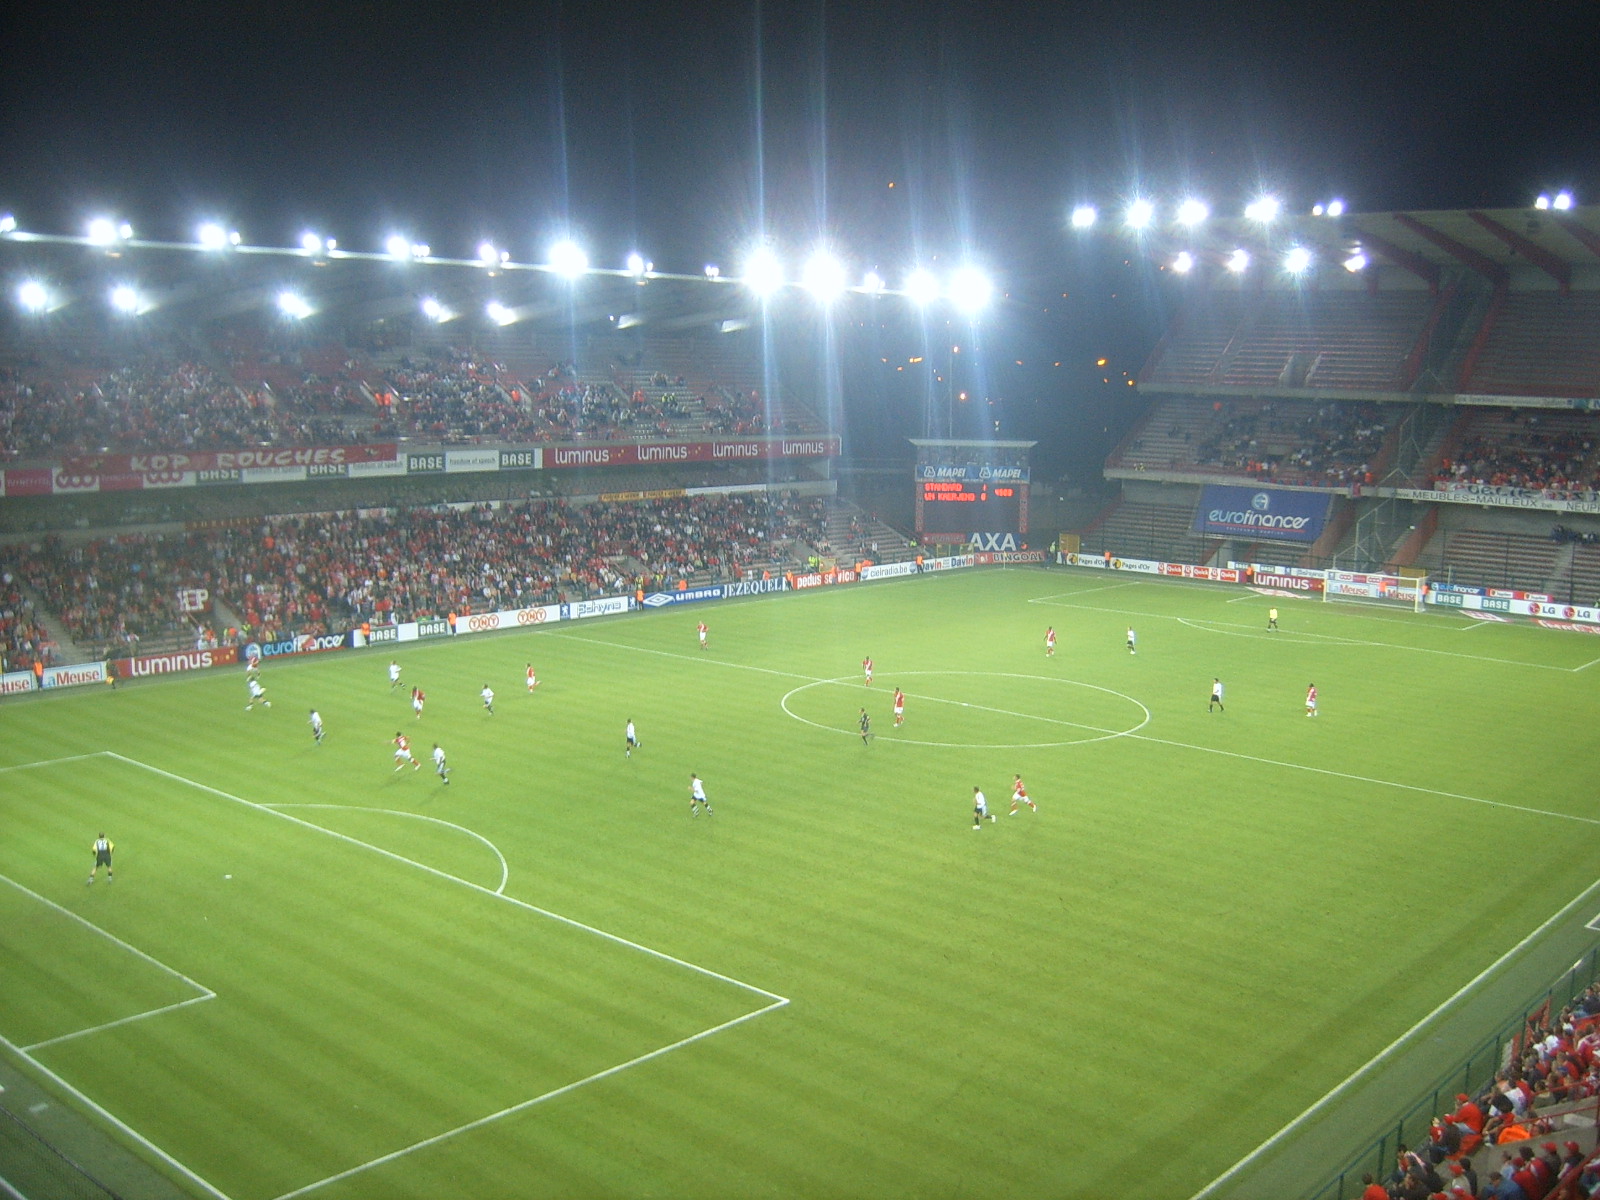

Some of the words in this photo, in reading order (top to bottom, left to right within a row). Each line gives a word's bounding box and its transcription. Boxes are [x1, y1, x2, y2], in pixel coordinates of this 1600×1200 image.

[637, 445, 687, 460] luminus
[713, 442, 758, 458] luminus
[782, 440, 824, 455] luminus
[502, 453, 531, 466] BASE
[555, 448, 609, 464] luminus
[410, 456, 443, 470] BASE
[937, 468, 966, 477] MAPEI
[992, 469, 1021, 478] MAPEI
[1412, 491, 1538, 508] MEUBLES-MAILLEUX
[968, 532, 1017, 551] AXA
[951, 556, 973, 567] Davin
[993, 552, 1044, 562] BINGOAL
[1122, 562, 1136, 570] Pages
[1167, 564, 1182, 573] Quick
[797, 573, 822, 588] pedus
[824, 569, 854, 584] sevice
[1193, 568, 1209, 577] Quick
[1221, 571, 1236, 580] Quick
[1254, 572, 1310, 590] luminus
[722, 578, 784, 599] JEZEQUEL
[1339, 584, 1368, 596] Meuse
[1438, 594, 1461, 604] BASE
[1483, 598, 1508, 608] BASE
[517, 608, 547, 625] TNT
[1543, 606, 1555, 615] LG
[1577, 610, 1590, 619] LG
[469, 614, 499, 631] TNT
[370, 628, 396, 640] BASE
[420, 623, 445, 635] BASE
[131, 652, 213, 676] luminus
[56, 670, 99, 685] Meuse
